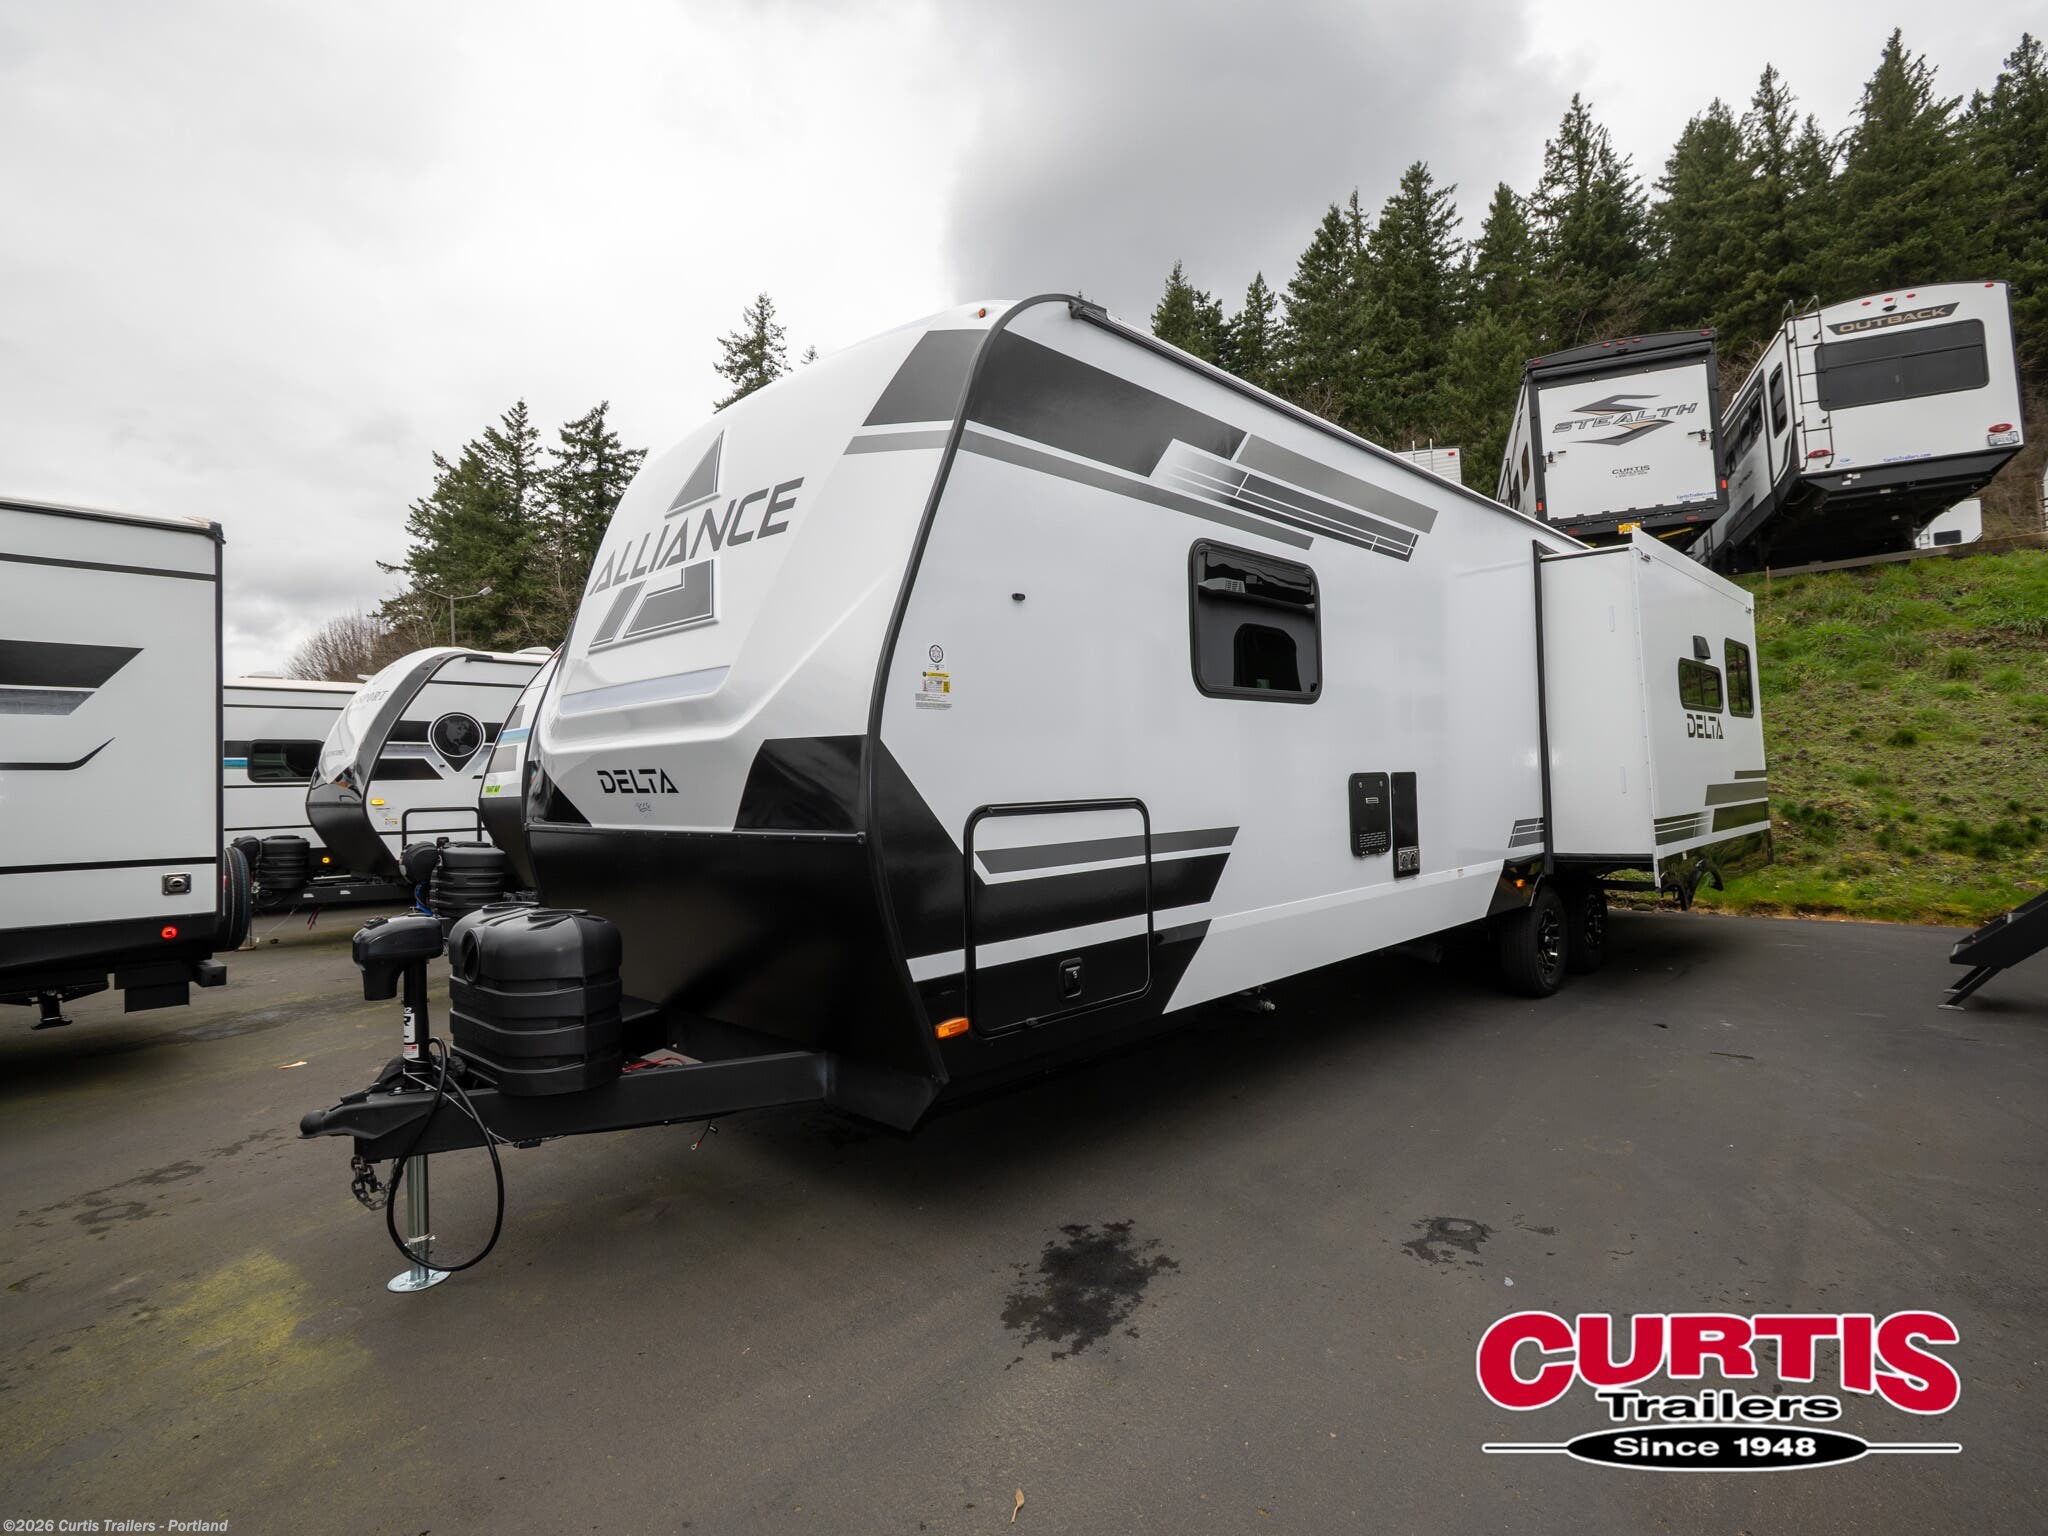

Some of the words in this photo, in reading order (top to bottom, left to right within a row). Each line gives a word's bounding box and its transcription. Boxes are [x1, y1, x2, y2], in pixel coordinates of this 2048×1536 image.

[1839, 307, 1948, 333] OUTBACK
[1552, 402, 1698, 433] STEALTH
[1611, 464, 1650, 474] CURTIS
[588, 476, 805, 597] ALLIANCE
[1686, 713, 1724, 740] DELTA
[596, 767, 680, 794] DELTA
